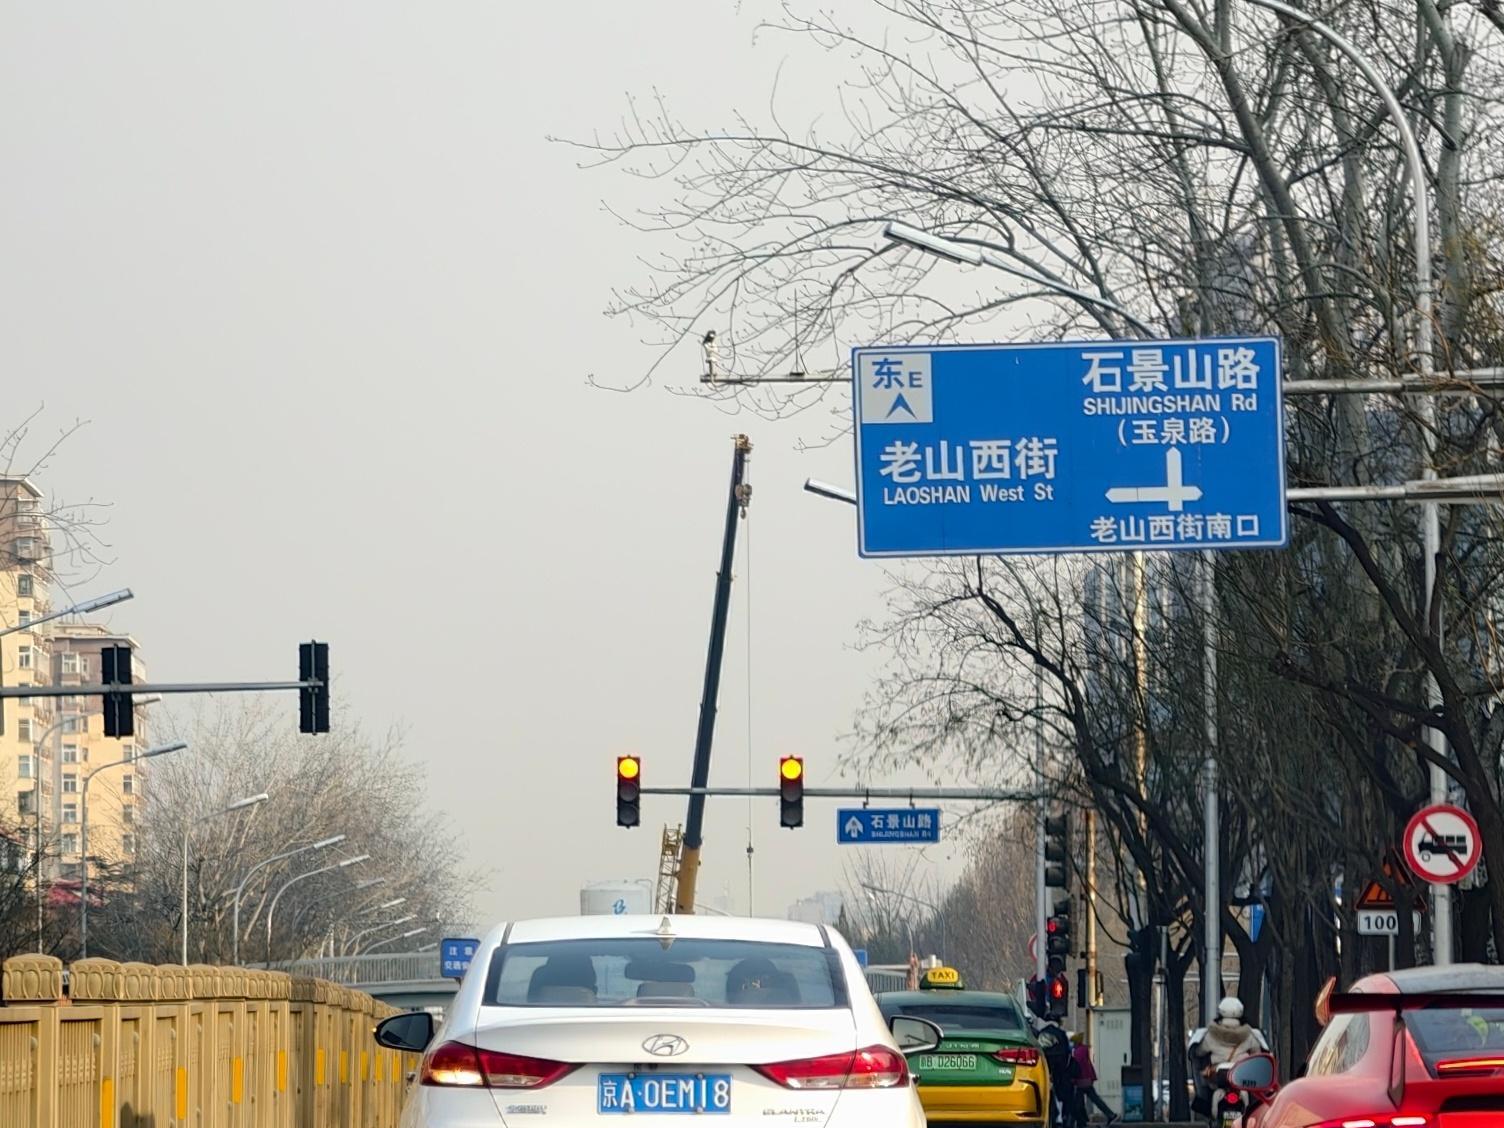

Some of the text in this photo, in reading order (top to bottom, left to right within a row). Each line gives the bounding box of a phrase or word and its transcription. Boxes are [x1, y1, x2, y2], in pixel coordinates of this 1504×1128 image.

[1081, 347, 1261, 393] 石景山路
[1083, 393, 1257, 416] SHIJINGSHAN Rd
[1118, 416, 1230, 446] （玉泉路）
[879, 437, 1058, 483] 老山西街
[883, 483, 1054, 505] LAOSHAN West St
[1090, 512, 1259, 543] 老山西街南口
[871, 813, 932, 829] 石景山路
[1364, 915, 1397, 930] 100
[932, 971, 955, 980] TAXI
